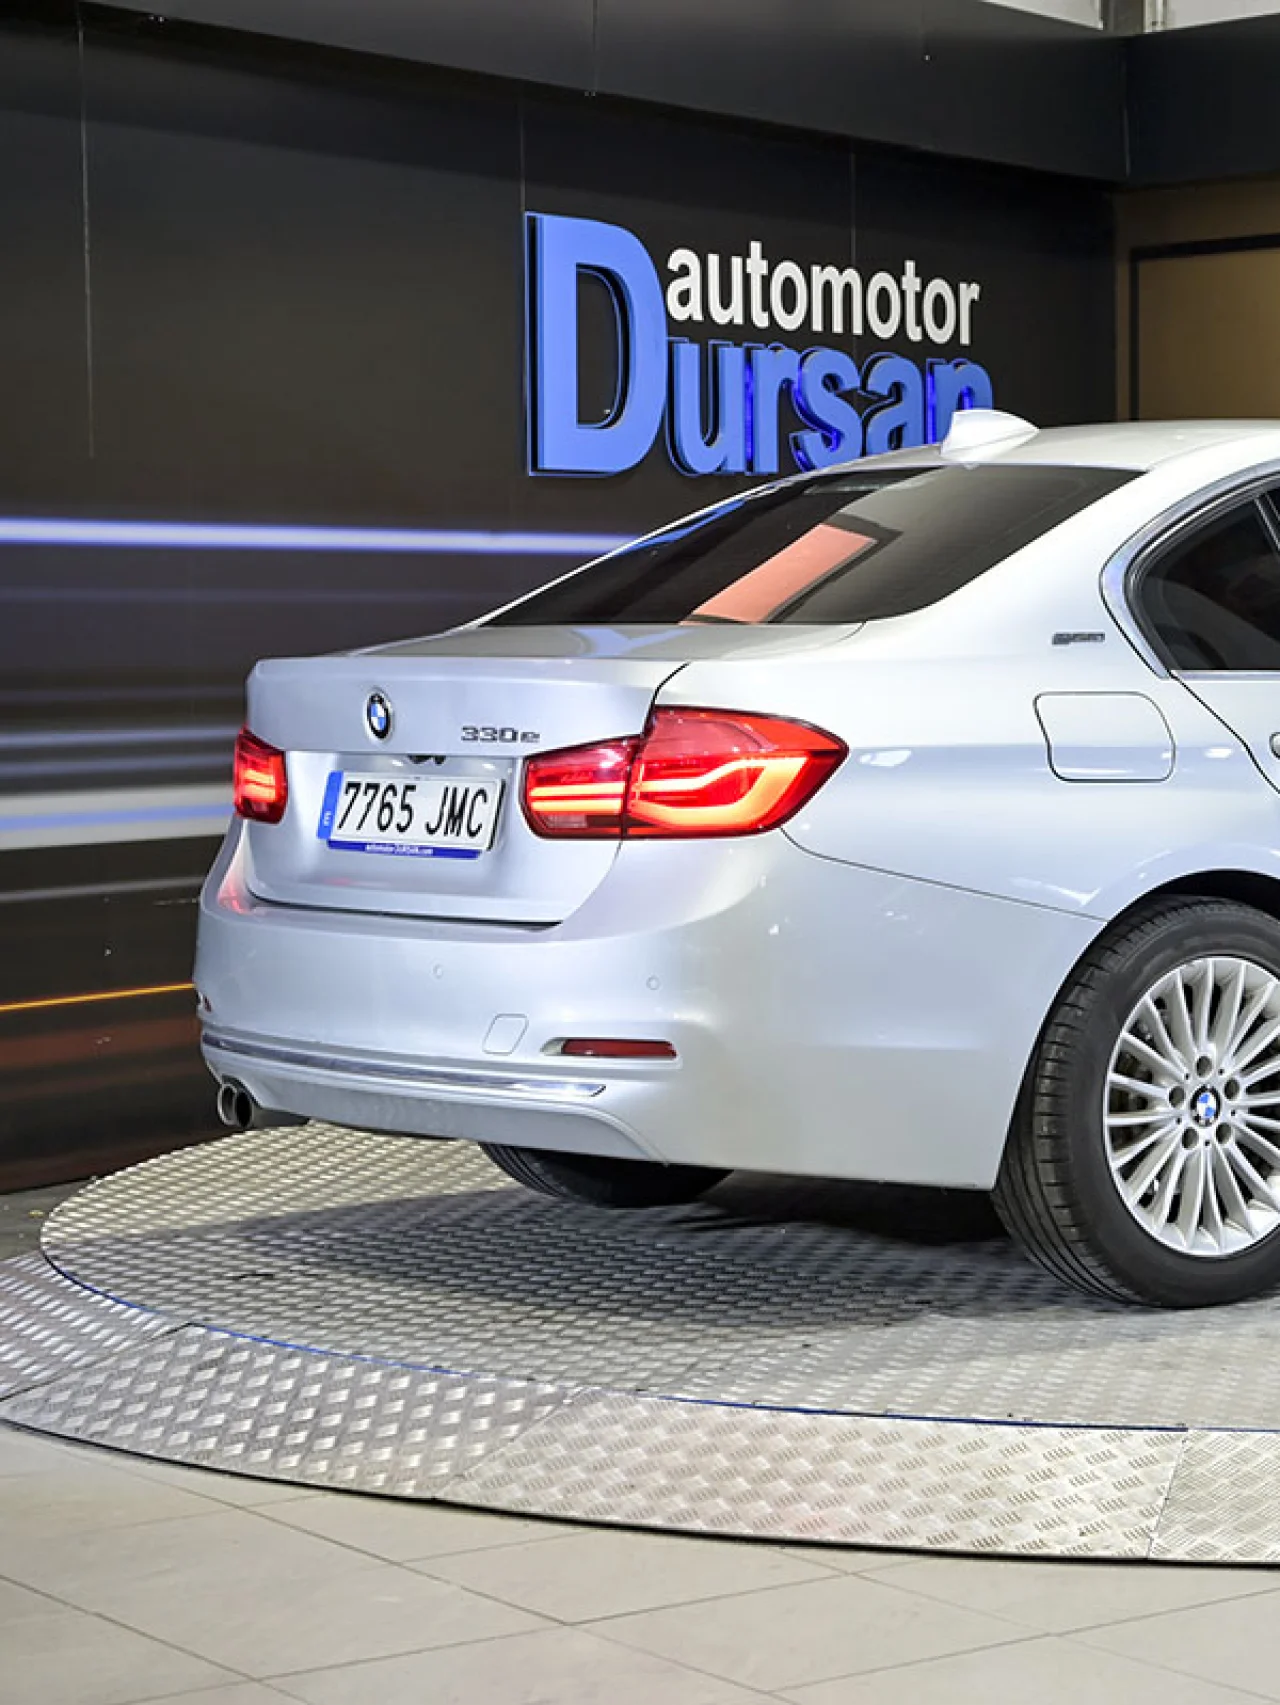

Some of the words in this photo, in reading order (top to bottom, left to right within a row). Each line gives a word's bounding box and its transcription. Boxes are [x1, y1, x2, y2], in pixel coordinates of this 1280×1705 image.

[666, 240, 980, 345] automotor
[524, 211, 993, 477] Dursan
[461, 726, 541, 743] 330e
[338, 780, 417, 833] 7765
[425, 786, 488, 838] JMC
